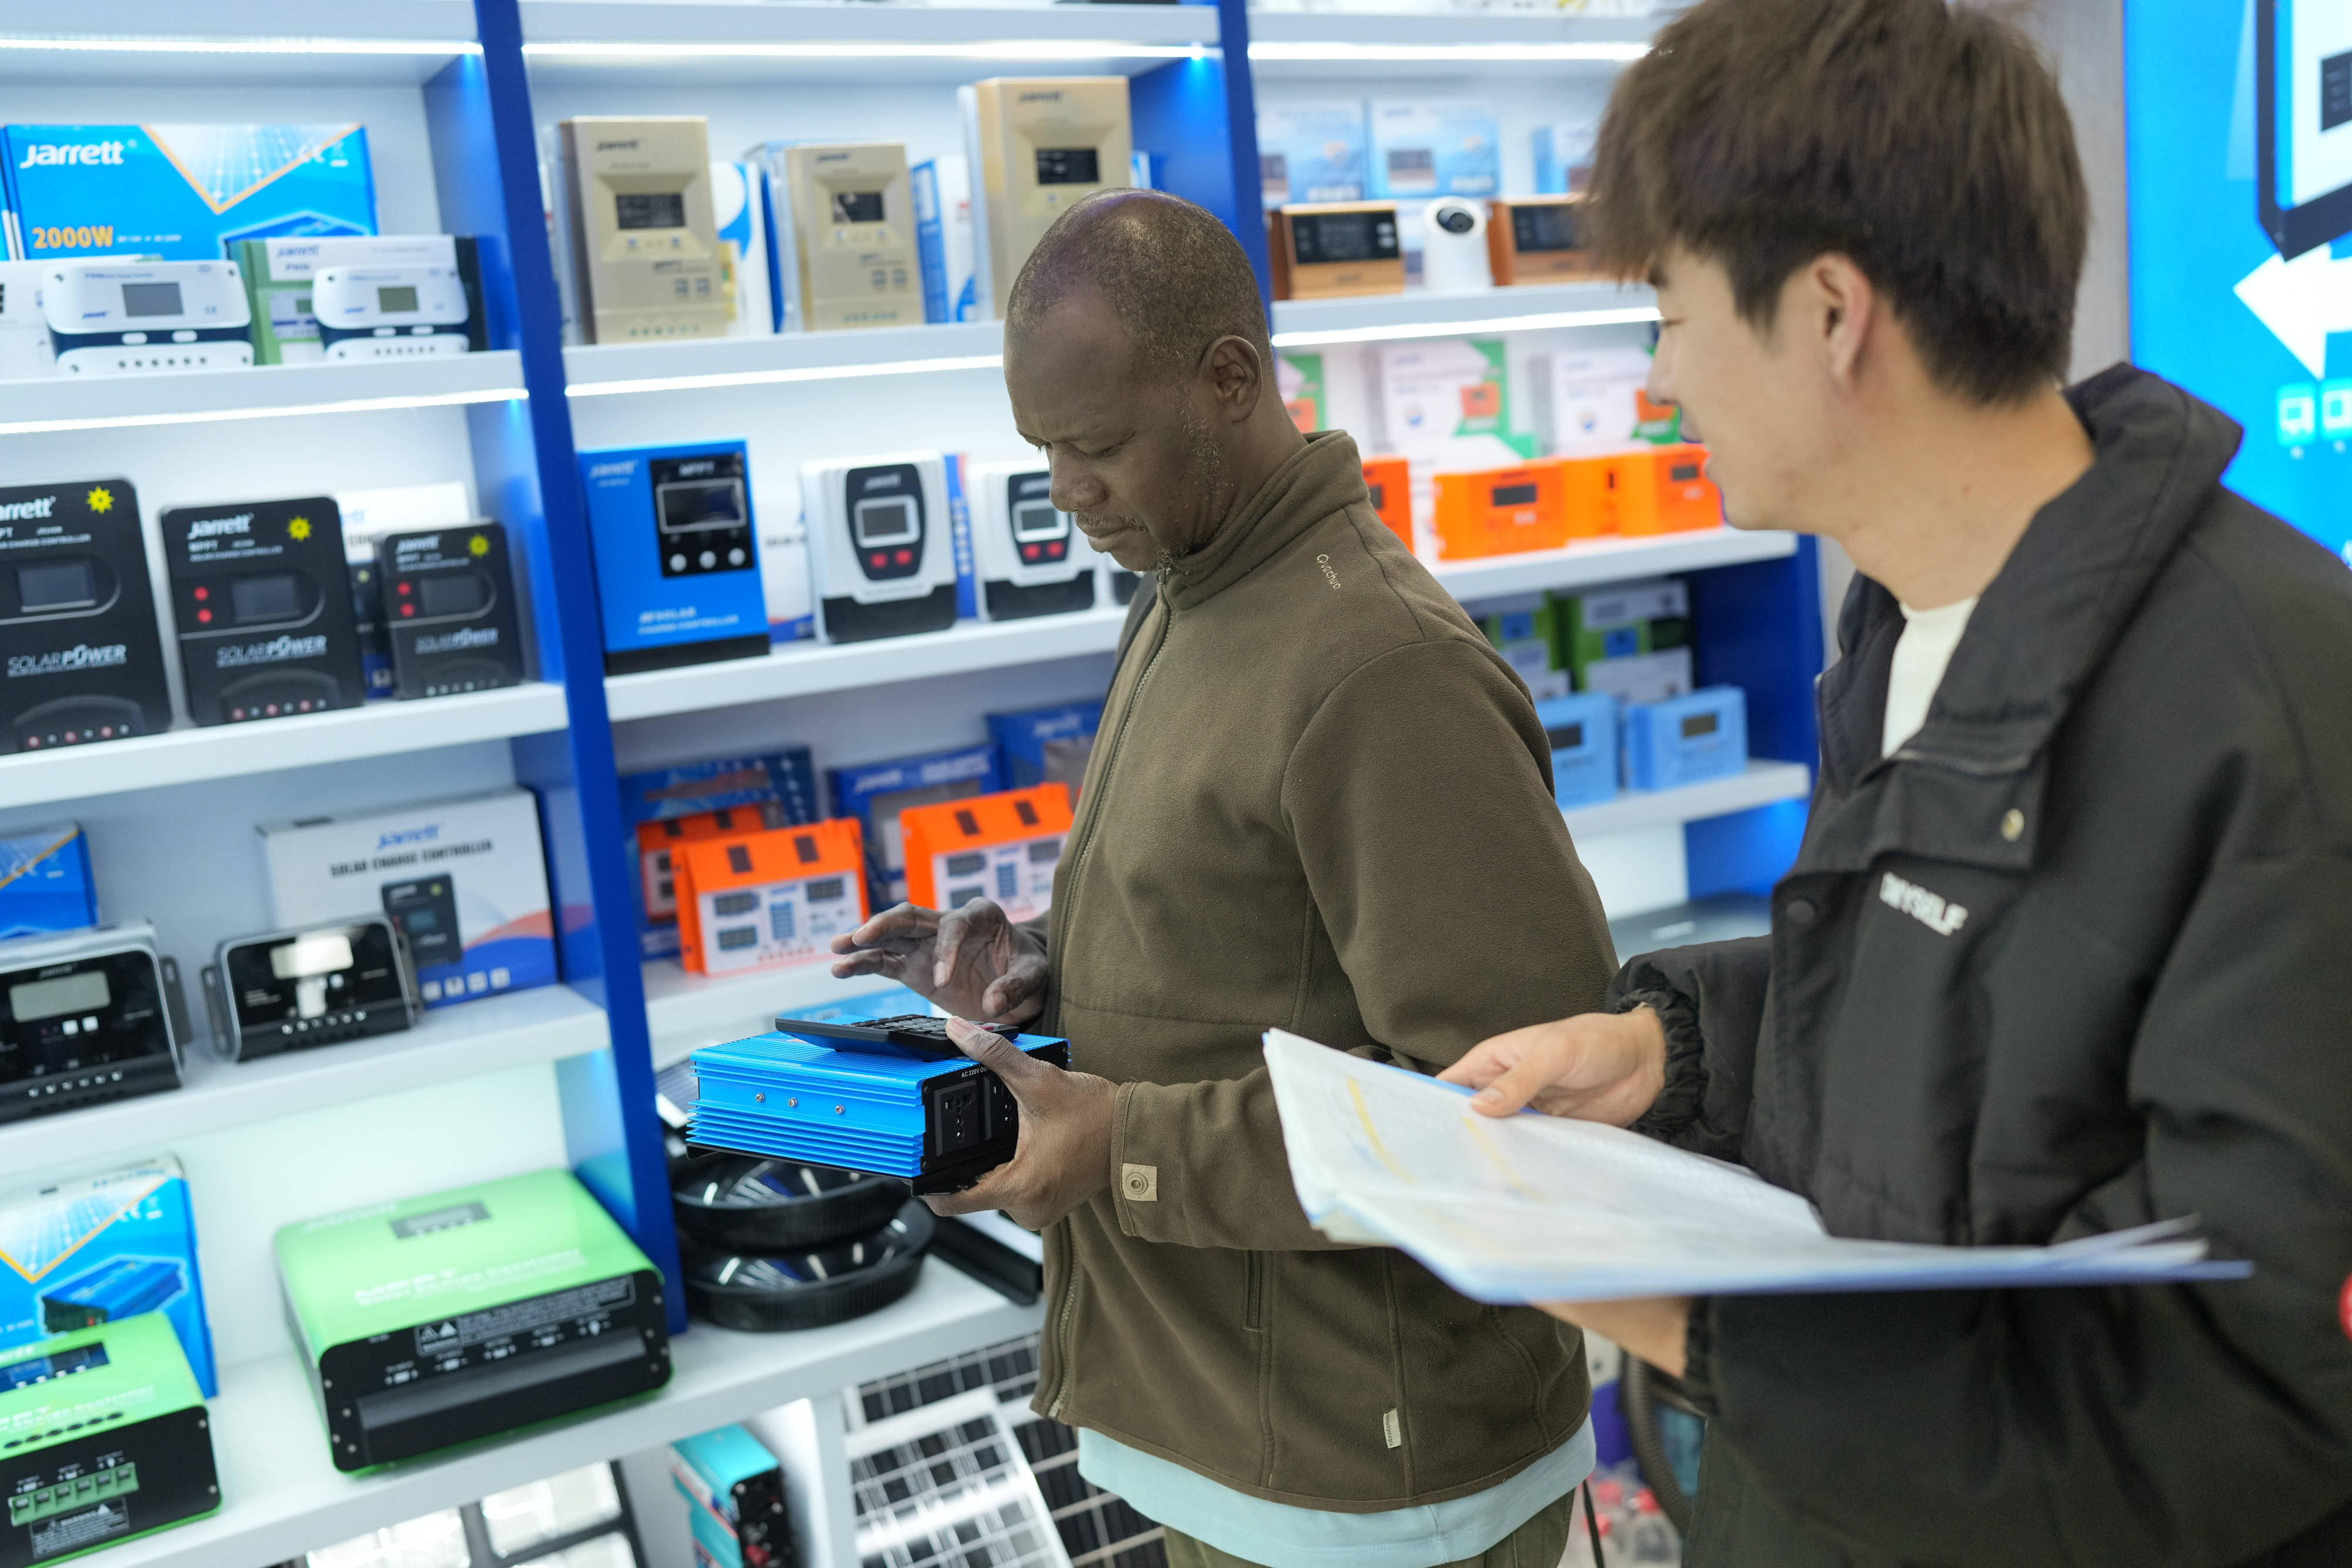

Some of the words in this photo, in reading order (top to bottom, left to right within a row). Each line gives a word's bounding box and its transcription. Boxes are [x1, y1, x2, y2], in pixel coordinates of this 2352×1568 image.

[19, 141, 125, 169] Jarrett
[32, 225, 113, 248] 2000W
[1317, 554, 1341, 590] Quechua
[968, 1068, 980, 1076] 220V
